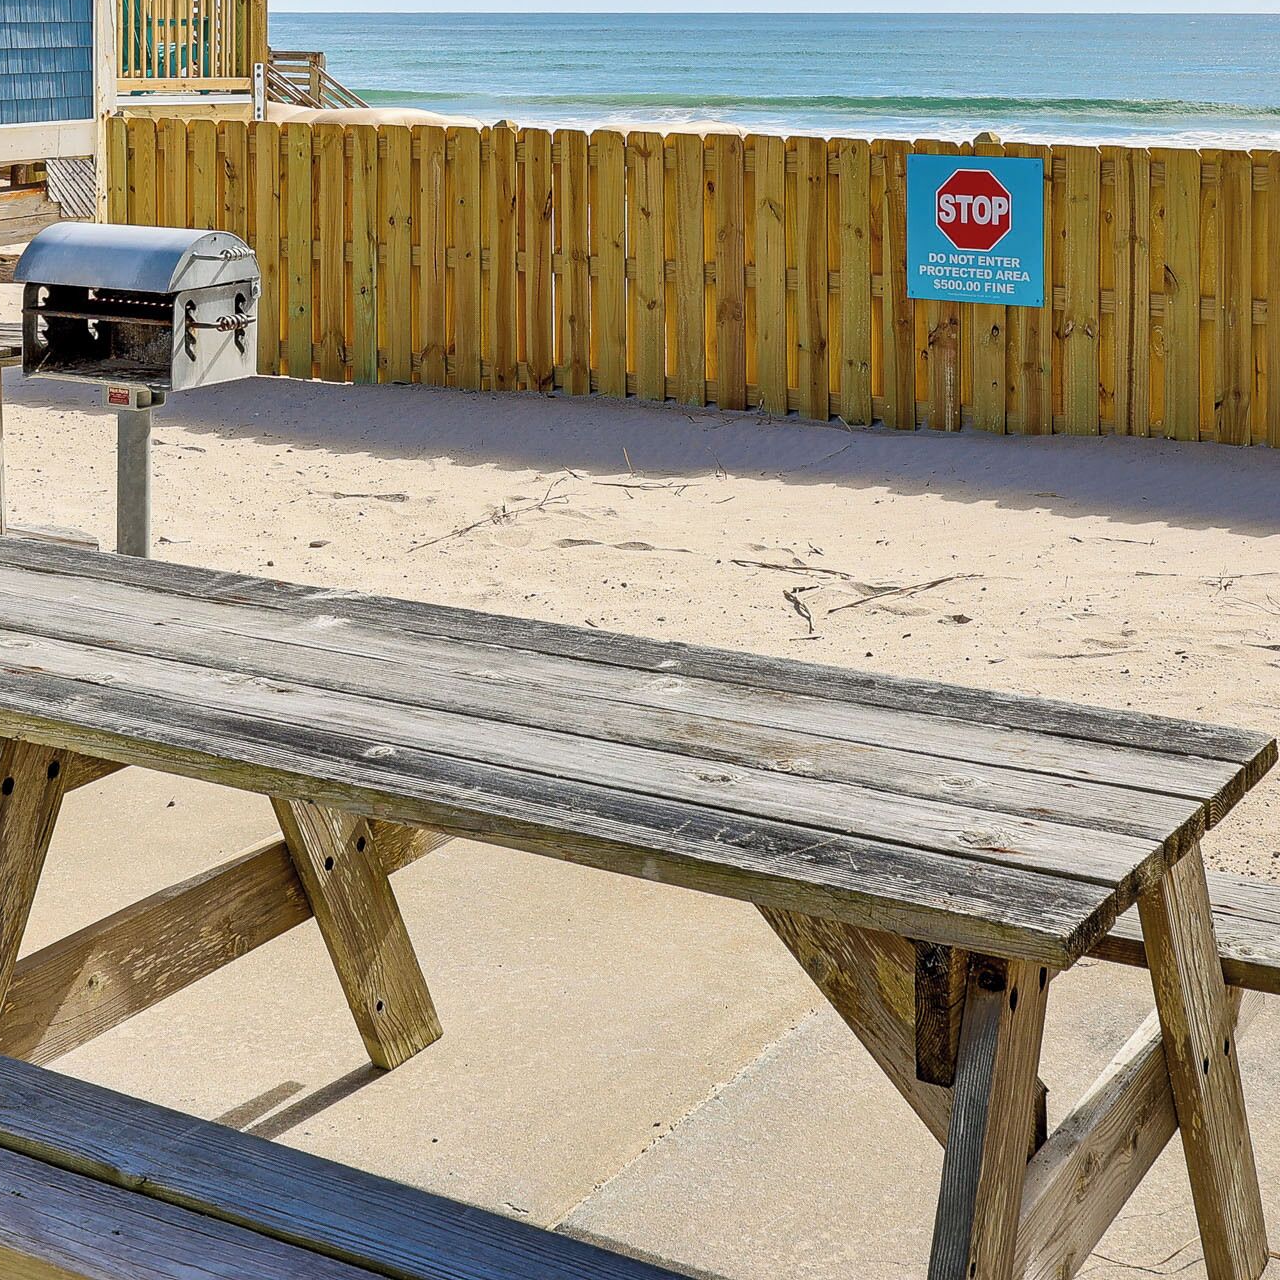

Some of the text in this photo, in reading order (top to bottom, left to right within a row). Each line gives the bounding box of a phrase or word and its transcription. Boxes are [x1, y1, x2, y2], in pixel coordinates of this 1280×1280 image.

[939, 193, 1008, 225] STOP
[928, 252, 1020, 268] DO NOT ENTER
[919, 264, 1030, 282] PROTECTED AREA
[933, 278, 1015, 294] $500.00 FINE
